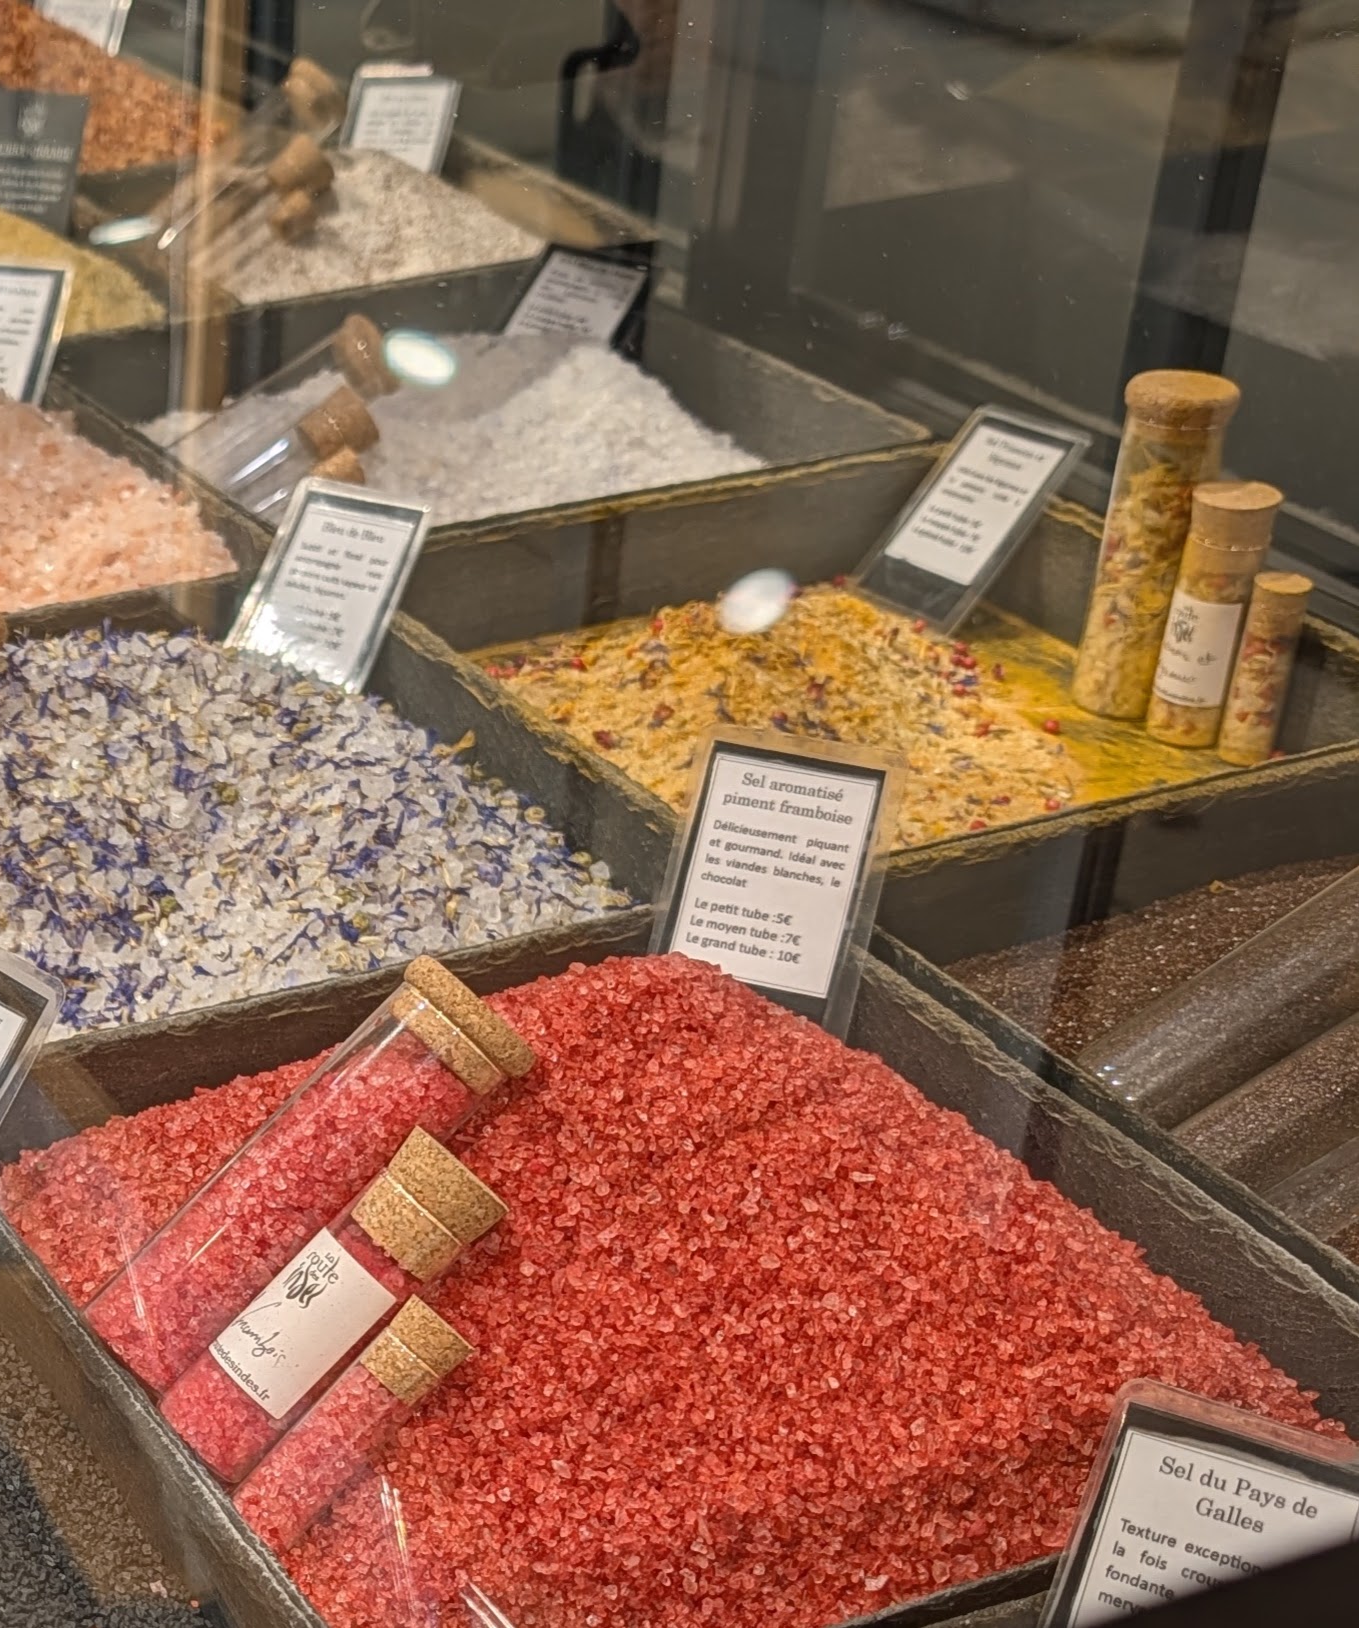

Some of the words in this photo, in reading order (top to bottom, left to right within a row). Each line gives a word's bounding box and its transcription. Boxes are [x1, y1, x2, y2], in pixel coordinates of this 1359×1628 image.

[742, 773, 767, 789] Sel
[769, 781, 844, 803] aromatisé
[723, 792, 776, 812] piment
[779, 800, 854, 825] framboise
[713, 820, 798, 845] Délicieusement
[806, 839, 850, 854] piquant
[705, 853, 721, 866] les
[726, 859, 768, 874] viandes
[773, 866, 825, 887] blanches,
[831, 877, 841, 888] le
[709, 839, 722, 848] et
[724, 842, 784, 860] gourmand.
[789, 852, 817, 865] Idéal
[820, 860, 846, 871] avec
[701, 871, 748, 888] chocolat
[695, 898, 709, 910] Le
[710, 903, 740, 916] petit
[742, 908, 770, 922] tube
[772, 913, 793, 926] :5€
[690, 915, 704, 927] Le
[706, 921, 748, 936] moyen
[750, 927, 779, 942] tube
[781, 933, 802, 947] :7€
[686, 932, 700, 944] Le
[701, 938, 737, 952] grand
[739, 943, 768, 958] tube
[777, 950, 802, 965] 10€
[1159, 1456, 1194, 1482] Sel
[1200, 1469, 1227, 1492] du
[1233, 1478, 1287, 1509] Pays
[1293, 1497, 1318, 1519] de
[1196, 1498, 1264, 1534] Galles
[1121, 1518, 1177, 1548] Texture
[1113, 1541, 1126, 1558] la
[1140, 1550, 1168, 1571] fois
[1105, 1565, 1176, 1602] fondante
